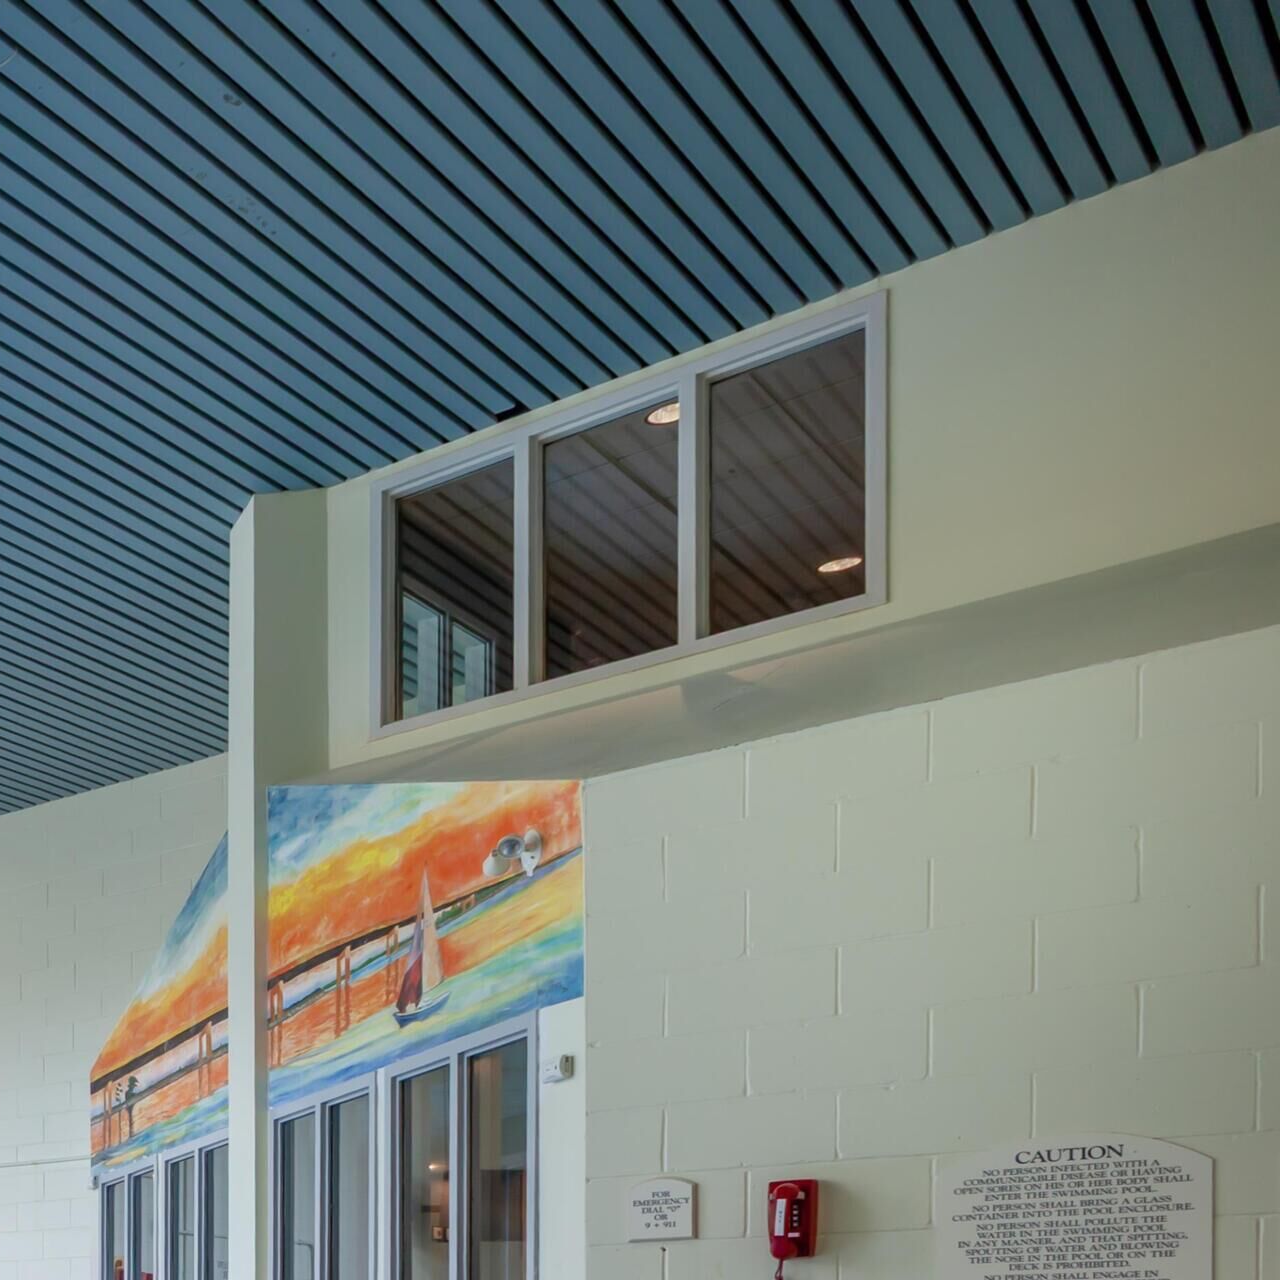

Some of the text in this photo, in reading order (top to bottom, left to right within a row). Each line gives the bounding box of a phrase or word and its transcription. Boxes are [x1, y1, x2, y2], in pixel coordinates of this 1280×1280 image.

[1015, 1144, 1124, 1164] CAUTION
[964, 1166, 1182, 1186] COMMUNICABLE DISEASE OR HAVING
[983, 1169, 1000, 1177] NO
[1004, 1166, 1047, 1176] PERSON
[1050, 1162, 1109, 1173] INFECTED
[1113, 1160, 1148, 1169] WITH
[953, 1174, 1194, 1196] OPEN SORES ON HIS OR HER BODY SHALL
[632, 1197, 690, 1207] EMERGENCY
[985, 1193, 1022, 1201] ENTER
[1025, 1191, 1049, 1199] THE
[1051, 1188, 1118, 1198] SWIMMING
[641, 1206, 664, 1214] DIAL
[972, 1205, 989, 1213] NO
[992, 1203, 1036, 1211] PERSON
[1039, 1200, 1077, 1209] SHALL
[1080, 1198, 1118, 1207] BRING
[1133, 1195, 1172, 1204] GLASS
[952, 1212, 1019, 1222] CONTAINER
[1022, 1210, 1053, 1218] INTO
[1056, 1208, 1080, 1217] THE
[1083, 1207, 1116, 1215] POOL
[976, 1215, 1168, 1232] NO PERSON SHALL POLLUTE THE
[976, 1230, 1016, 1239] WATER
[1035, 1229, 1060, 1237] THE
[1062, 1226, 1129, 1236] SWIMMING
[1133, 1224, 1167, 1232] POOL
[958, 1241, 971, 1249] IN
[974, 1240, 997, 1248] ANY
[1060, 1235, 1087, 1244] AND
[1090, 1234, 1125, 1243] THAT
[1026, 1246, 1041, 1254] OF
[1044, 1245, 1086, 1253] WATER
[1089, 1243, 1117, 1252] AND
[1120, 1241, 1179, 1250] BLOWING
[968, 1256, 992, 1264] THE
[994, 1255, 1025, 1263] NOSE
[1043, 1253, 1068, 1261] THE
[1071, 1252, 1104, 1260] POOL
[1127, 1251, 1146, 1259] ON
[1149, 1250, 1176, 1258] THE
[1009, 1263, 1040, 1271] DECK
[1051, 1272, 1089, 1280] SHALL
[1092, 1271, 1141, 1279] ENGAGE
[1144, 1270, 1159, 1278] IN
